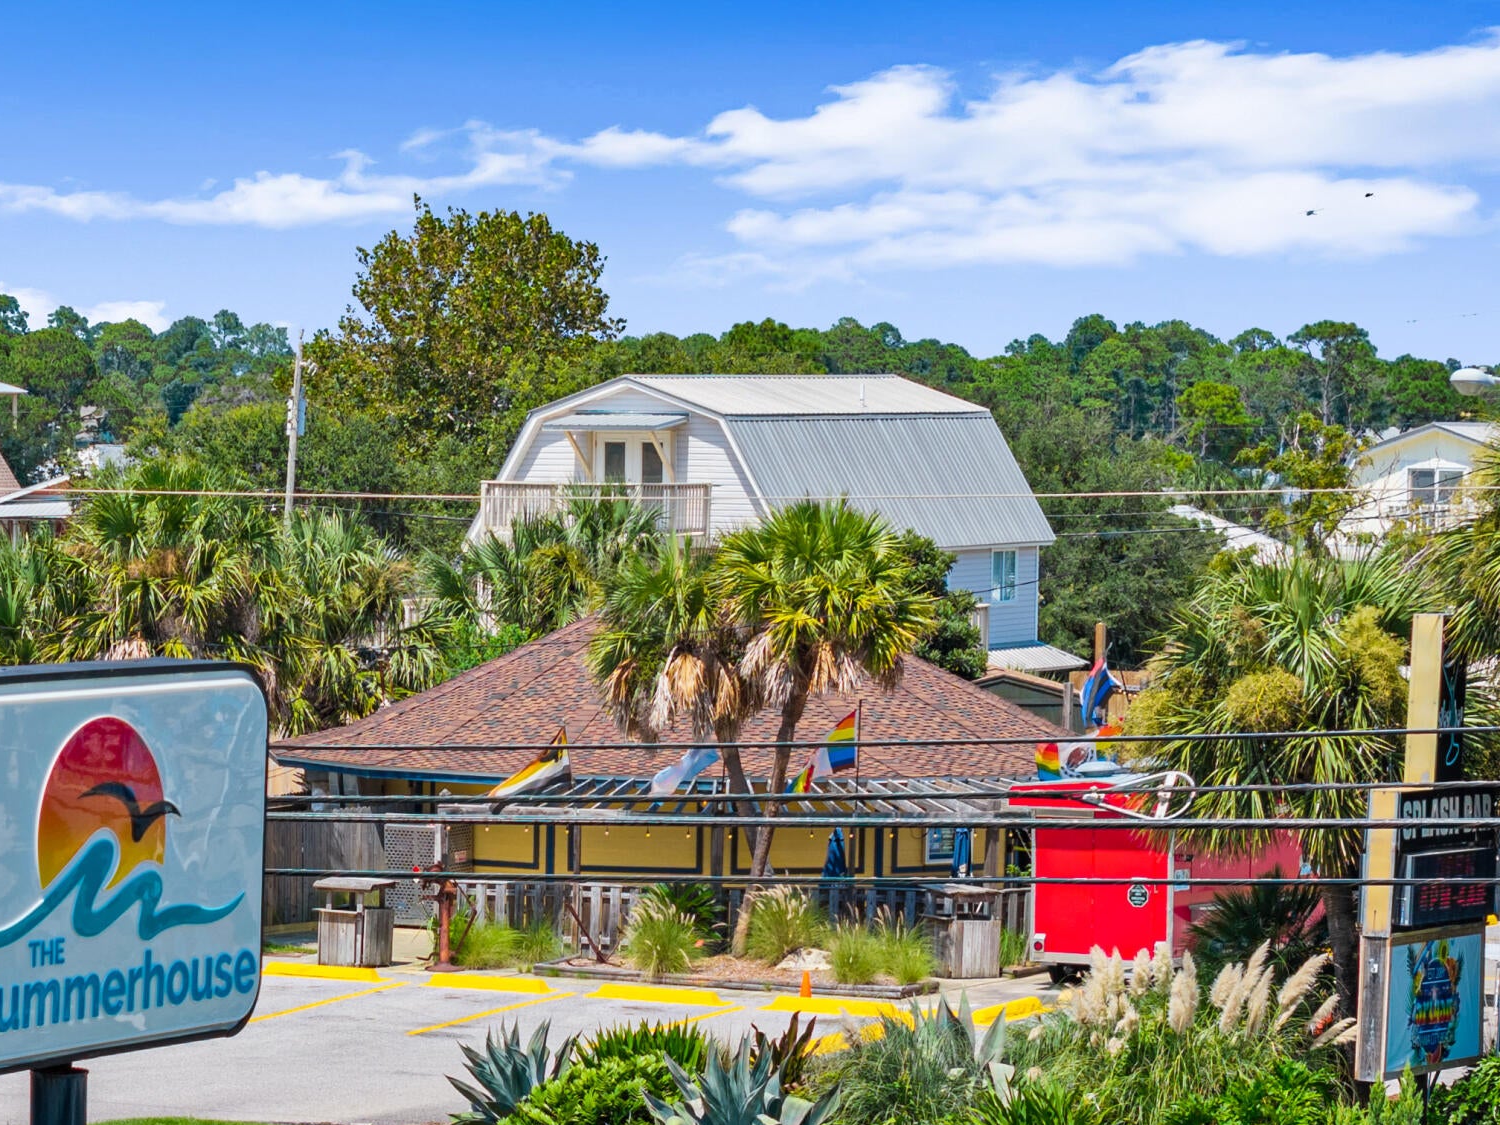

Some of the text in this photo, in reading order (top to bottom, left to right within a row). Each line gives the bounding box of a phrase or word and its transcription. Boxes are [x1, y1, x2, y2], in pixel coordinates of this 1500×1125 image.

[1402, 794, 1492, 840] SPLASH BAR
[29, 938, 65, 967] THE
